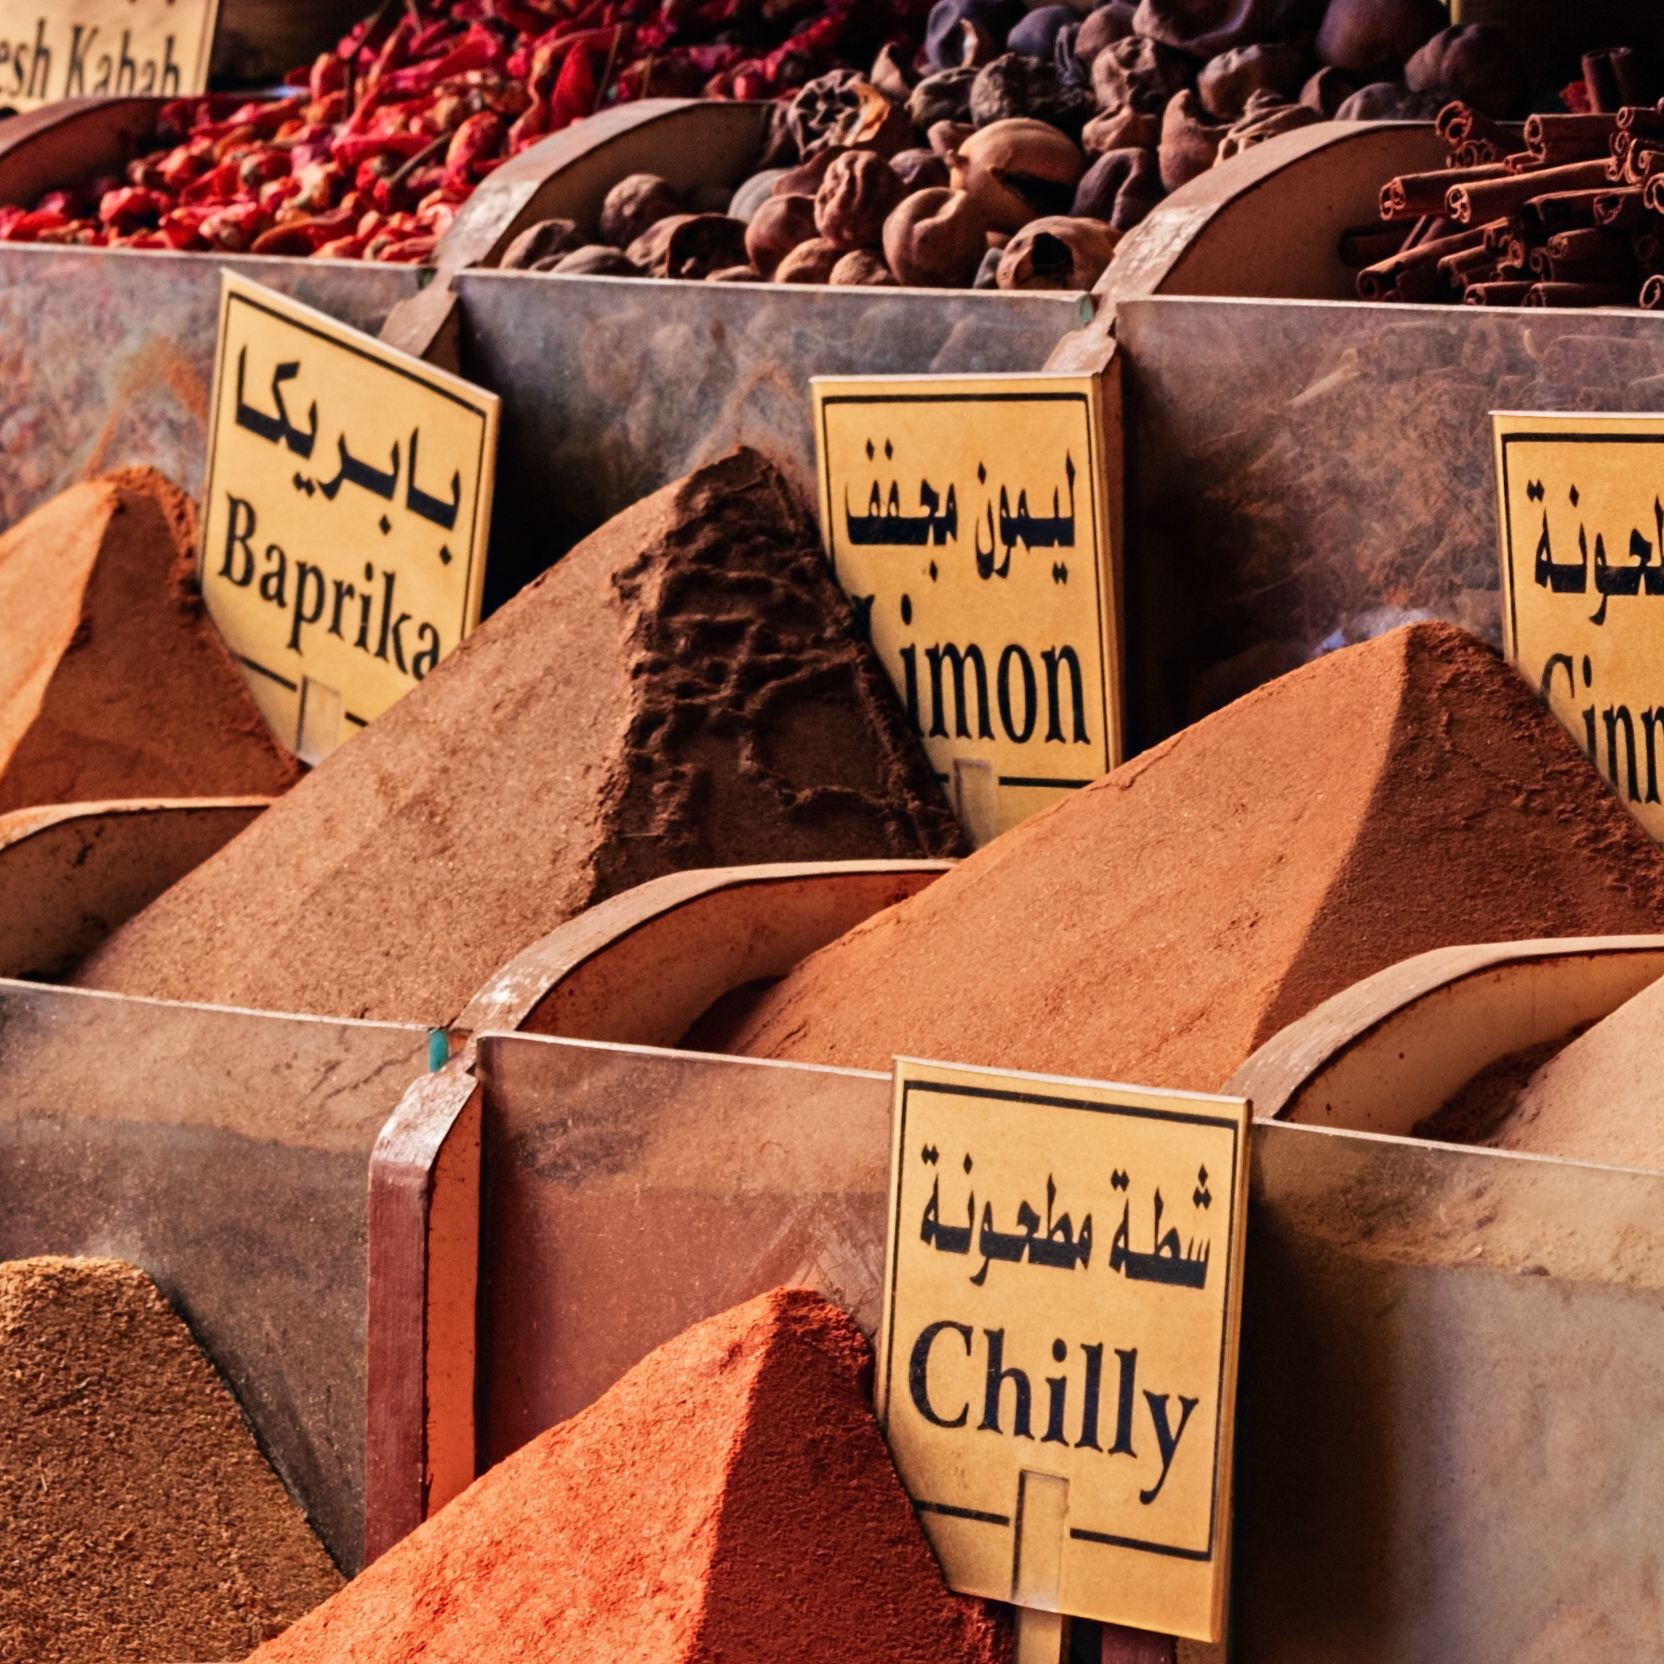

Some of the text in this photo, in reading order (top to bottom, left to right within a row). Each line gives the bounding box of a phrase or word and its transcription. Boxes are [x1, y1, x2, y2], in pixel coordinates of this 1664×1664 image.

[235, 343, 462, 566] بابريكا
[845, 438, 1076, 584] ليمون مجفف
[217, 494, 443, 681] Baprika
[919, 1143, 1211, 1290] شطة مطحونة
[908, 1319, 1199, 1505] Chilly
